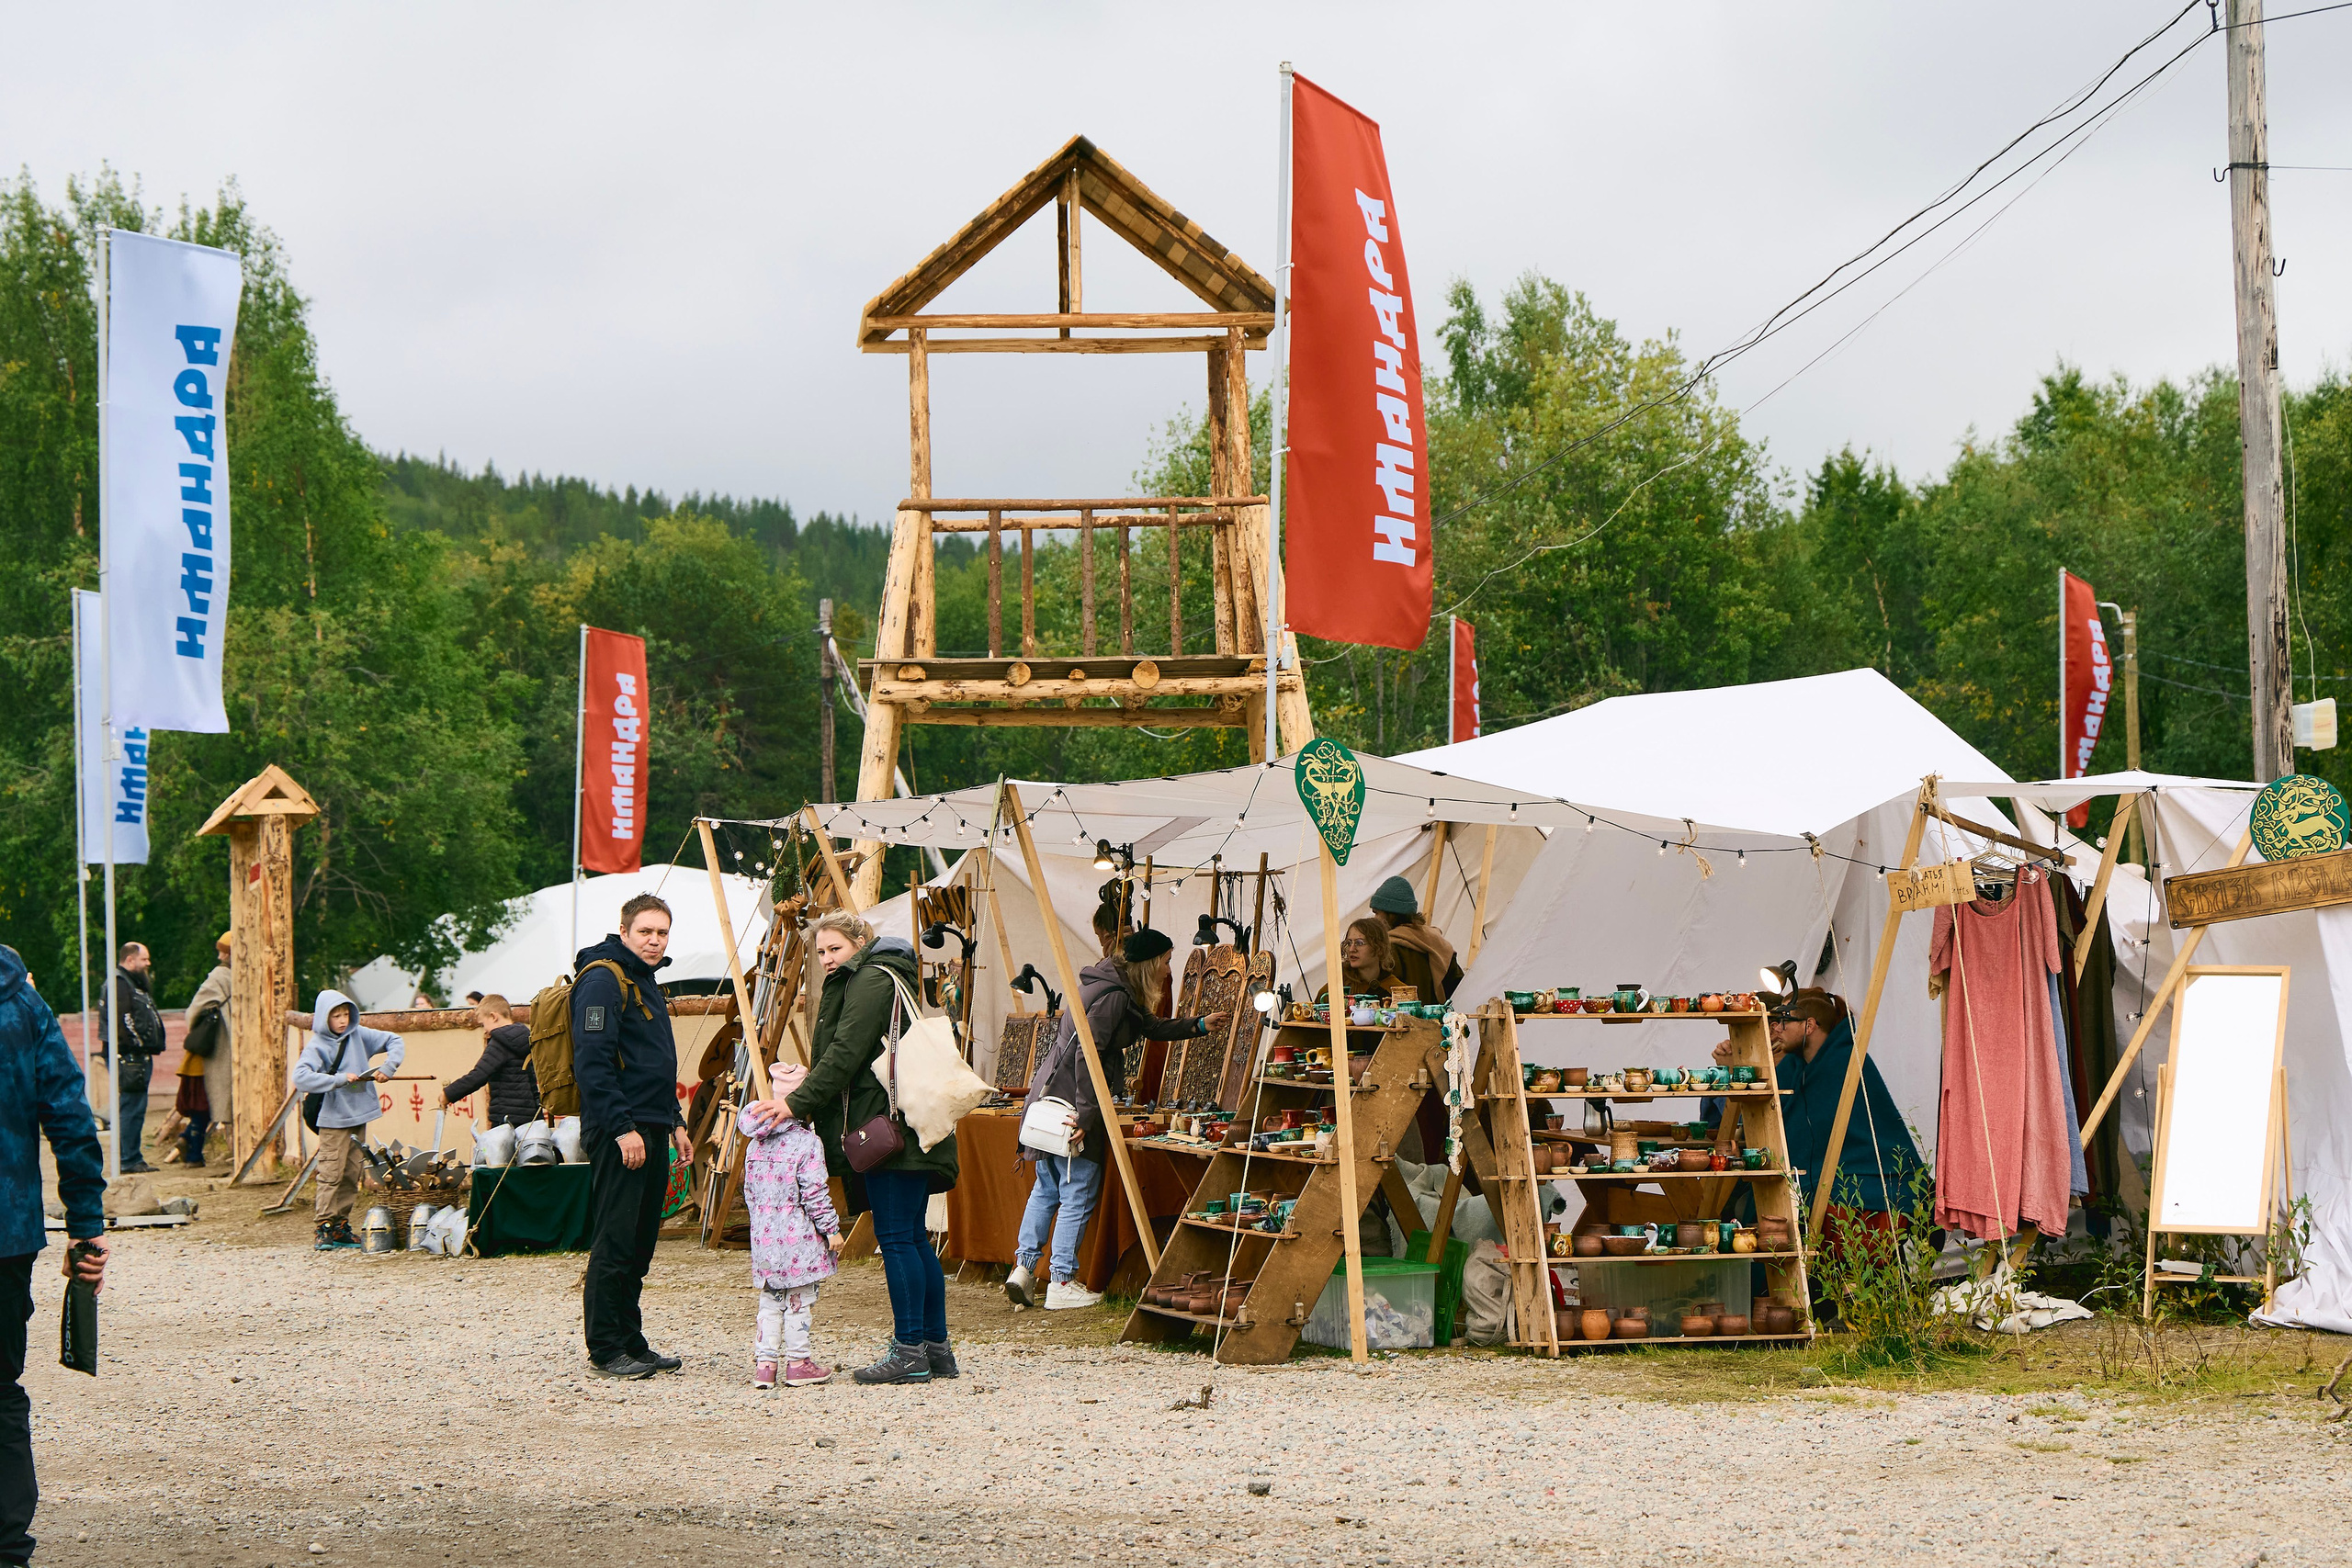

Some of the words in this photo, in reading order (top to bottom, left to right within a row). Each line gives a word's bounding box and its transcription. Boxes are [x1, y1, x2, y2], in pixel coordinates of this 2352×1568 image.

[1355, 187, 1416, 568] ИМАНДРА
[174, 323, 221, 660] ИМАНДРА
[611, 672, 641, 840] ИМАНДРА
[2075, 618, 2111, 778] МАНДРА
[2177, 875, 2262, 917] СВЯЗЬ
